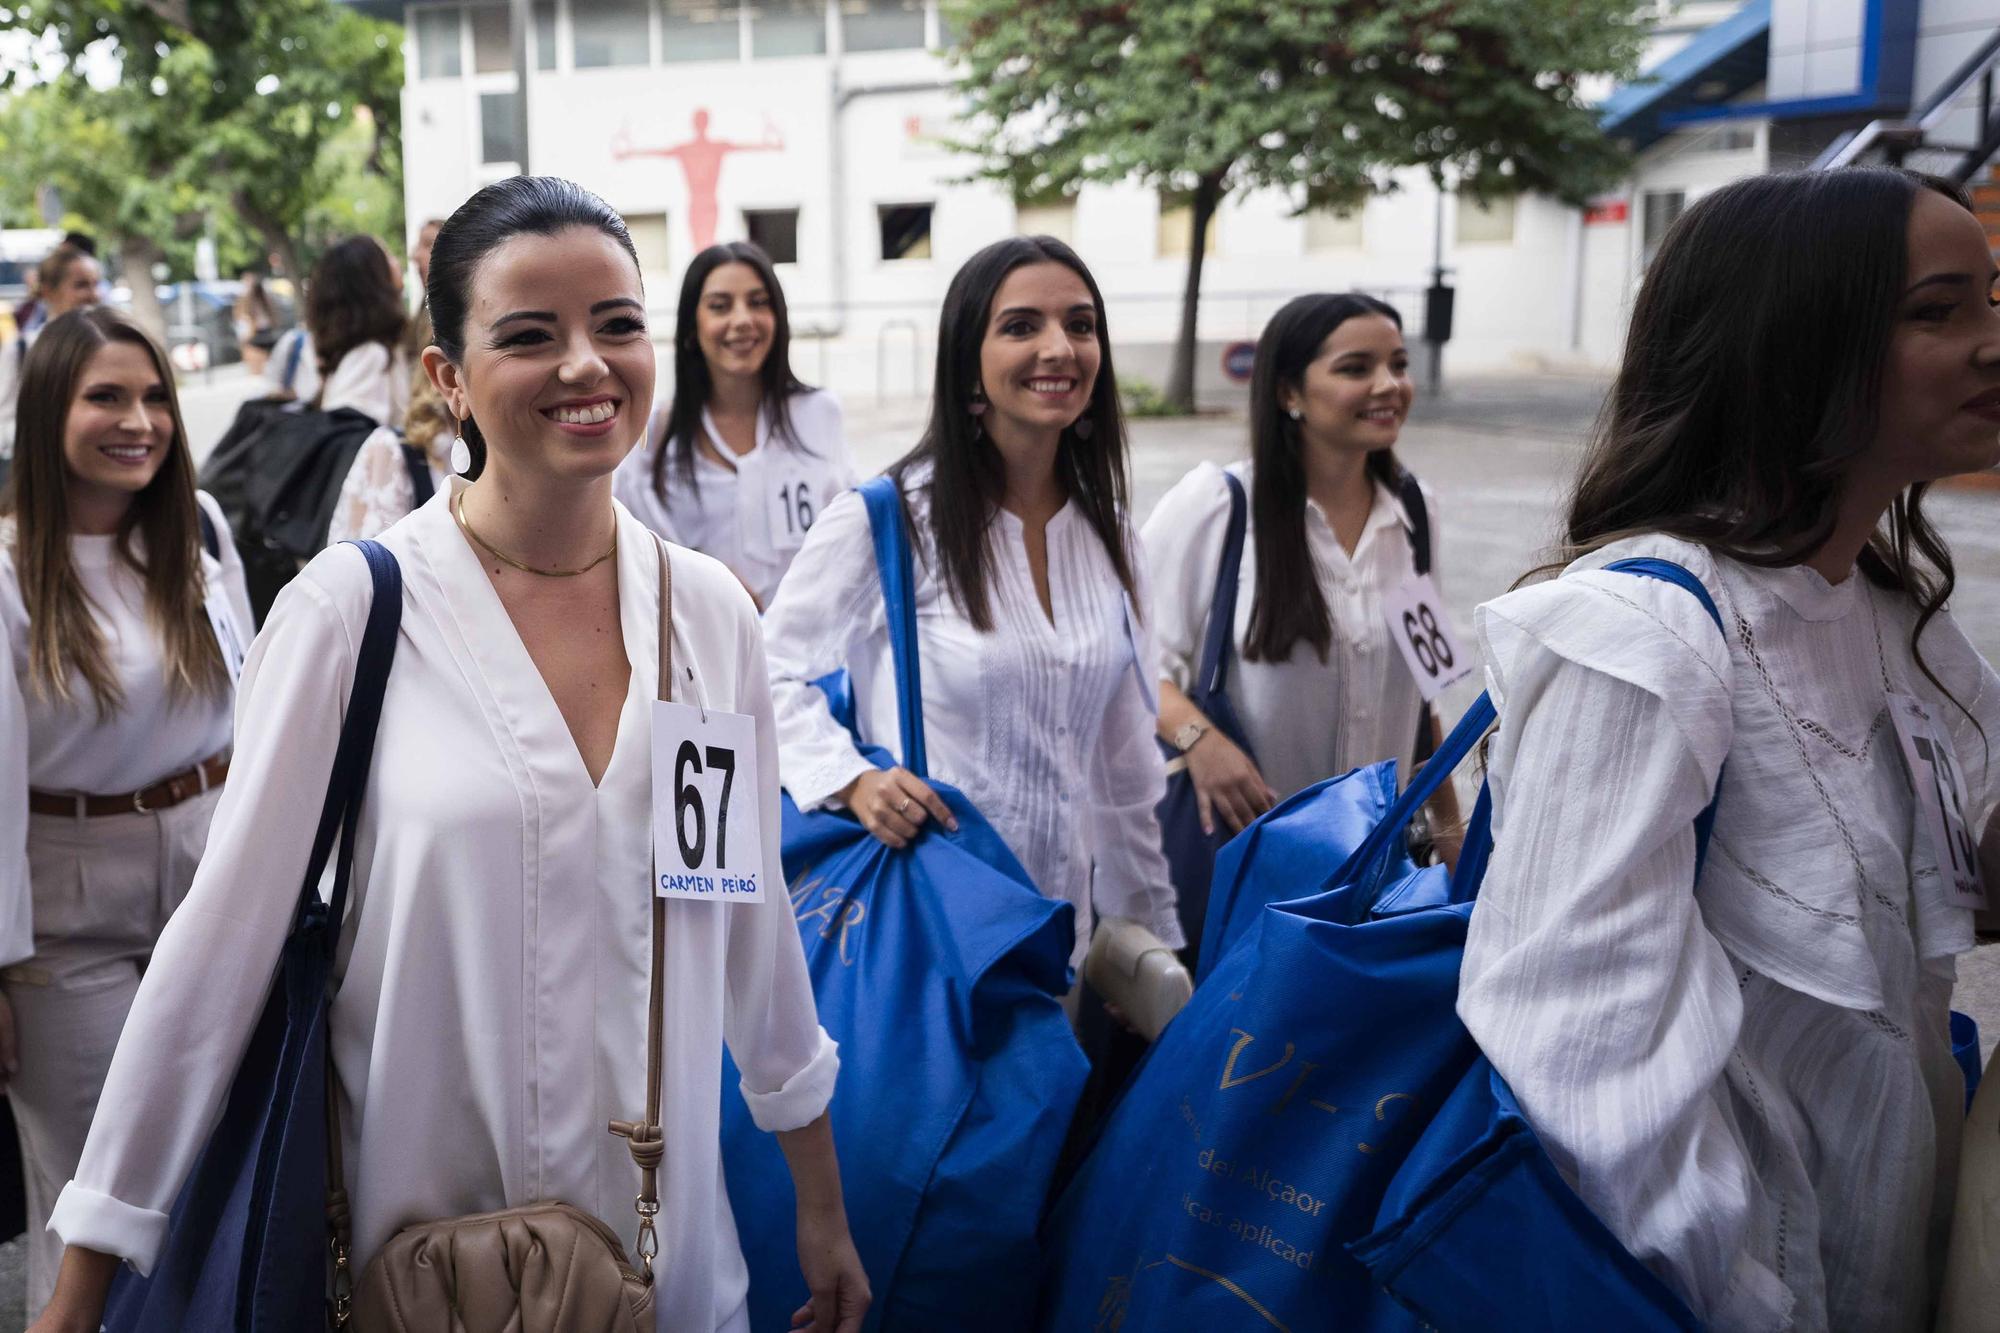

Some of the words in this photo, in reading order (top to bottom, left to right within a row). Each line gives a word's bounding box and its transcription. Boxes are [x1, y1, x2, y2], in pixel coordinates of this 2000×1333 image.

[779, 482, 814, 534] 16
[1402, 602, 1454, 679] 68
[674, 739, 735, 870] 67
[660, 873, 714, 893] CARMEN
